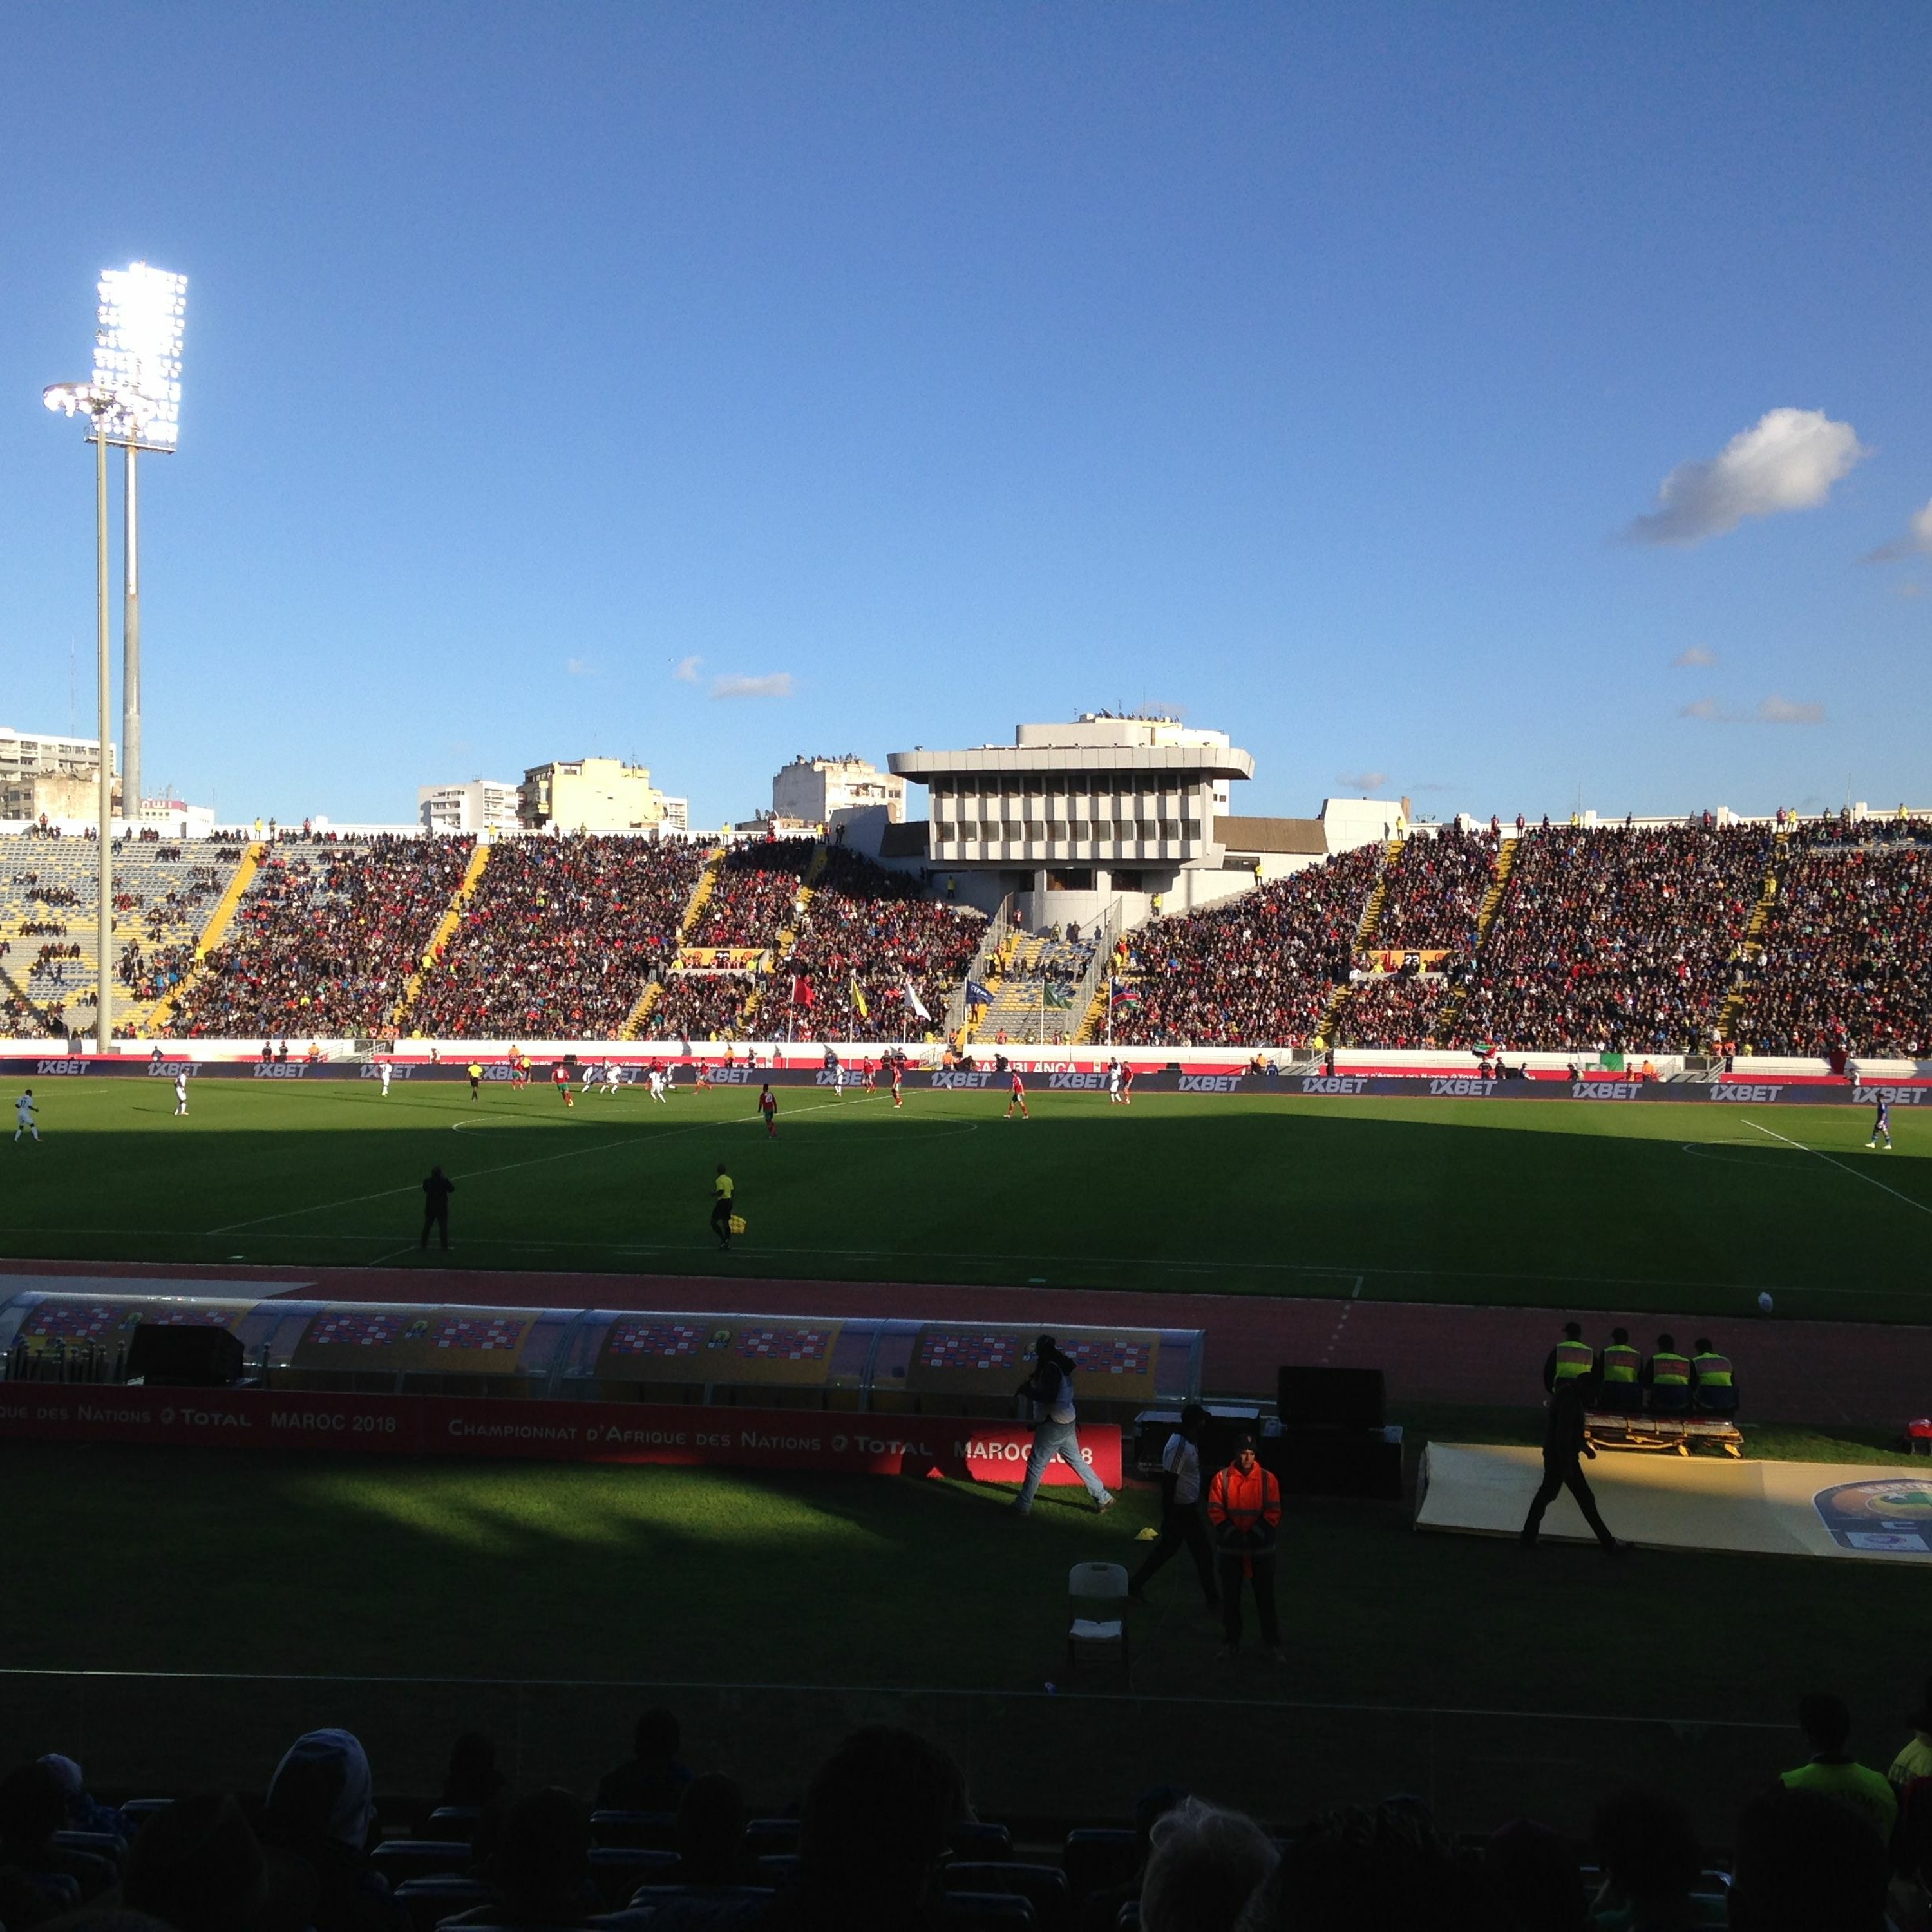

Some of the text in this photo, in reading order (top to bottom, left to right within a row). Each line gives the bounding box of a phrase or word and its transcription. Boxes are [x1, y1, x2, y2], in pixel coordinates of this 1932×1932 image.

[37, 1060, 90, 1075] 1XBET
[254, 1063, 308, 1078] 1XBET
[360, 1064, 415, 1079] 1XET
[815, 1070, 862, 1086] 1XBE
[931, 1072, 992, 1088] 1XBET
[1049, 1073, 1109, 1088] 1XBET
[1178, 1076, 1242, 1092] 1XBET
[1302, 1077, 1368, 1094] 1XBET
[1430, 1080, 1498, 1095] 1XBET
[1572, 1083, 1643, 1099] 1XBET
[1710, 1084, 1784, 1102] 1XBET
[1852, 1086, 1927, 1104] 1XBET
[270, 1412, 345, 1430] MAROC
[352, 1415, 397, 1433] 2018
[954, 1440, 1032, 1462] MAROC
